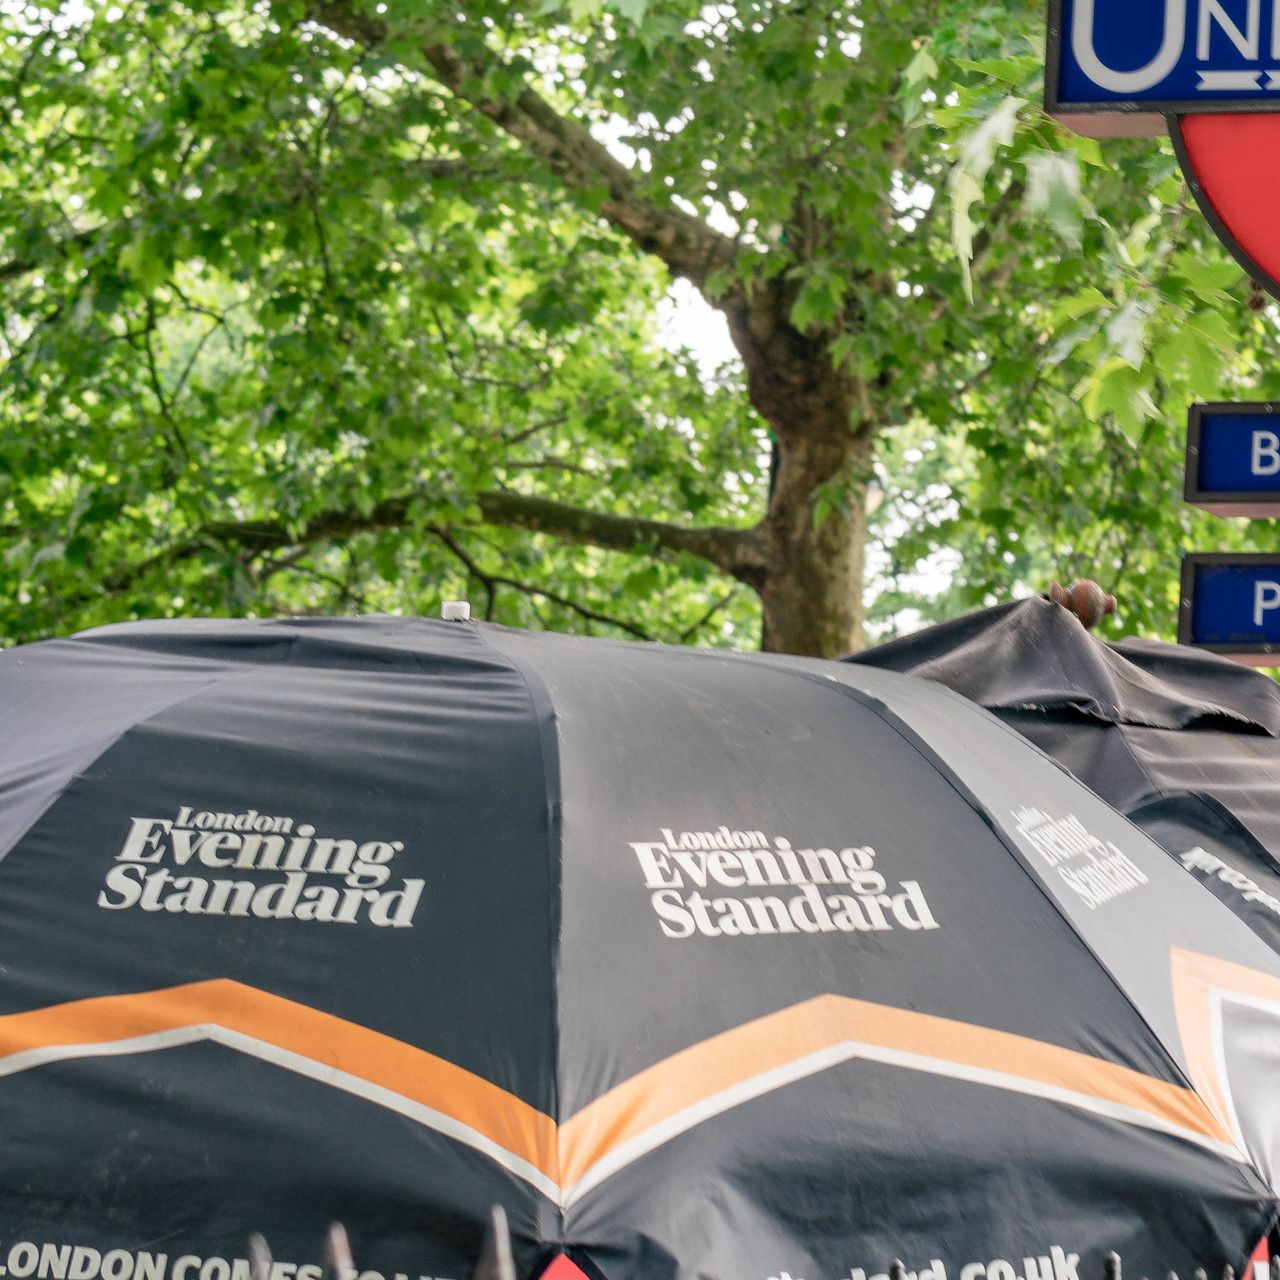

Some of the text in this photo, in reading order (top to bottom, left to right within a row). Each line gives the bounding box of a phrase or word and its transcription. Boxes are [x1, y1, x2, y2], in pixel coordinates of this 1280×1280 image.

[175, 806, 294, 835] London
[660, 825, 771, 851] London
[115, 817, 405, 889] Evening
[628, 836, 888, 895] Evening
[97, 863, 426, 929] Standard
[650, 880, 941, 939] Standard
